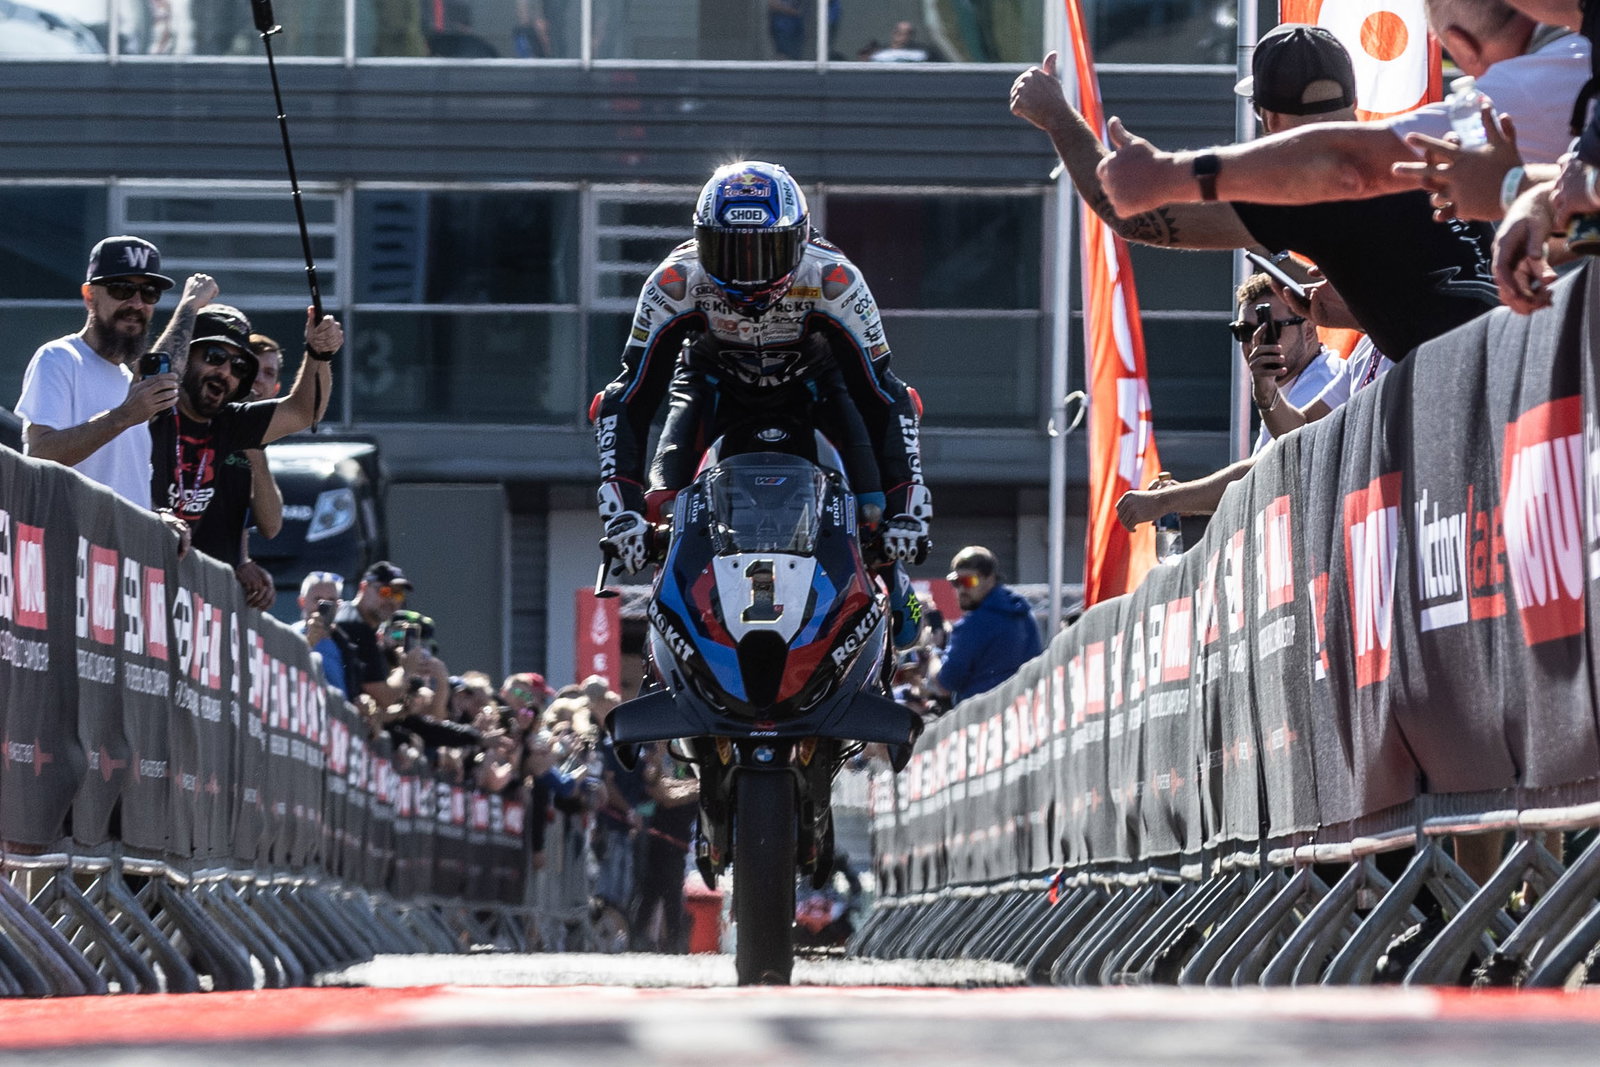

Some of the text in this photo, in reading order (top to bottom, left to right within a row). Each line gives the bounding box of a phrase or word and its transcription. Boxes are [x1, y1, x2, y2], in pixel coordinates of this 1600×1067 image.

[750, 187, 771, 197] Bull
[730, 210, 762, 221] SHOEI
[125, 246, 150, 269] W
[740, 559, 784, 624] 1
[648, 602, 695, 662] ROKiT
[831, 602, 886, 668] ROKiT
